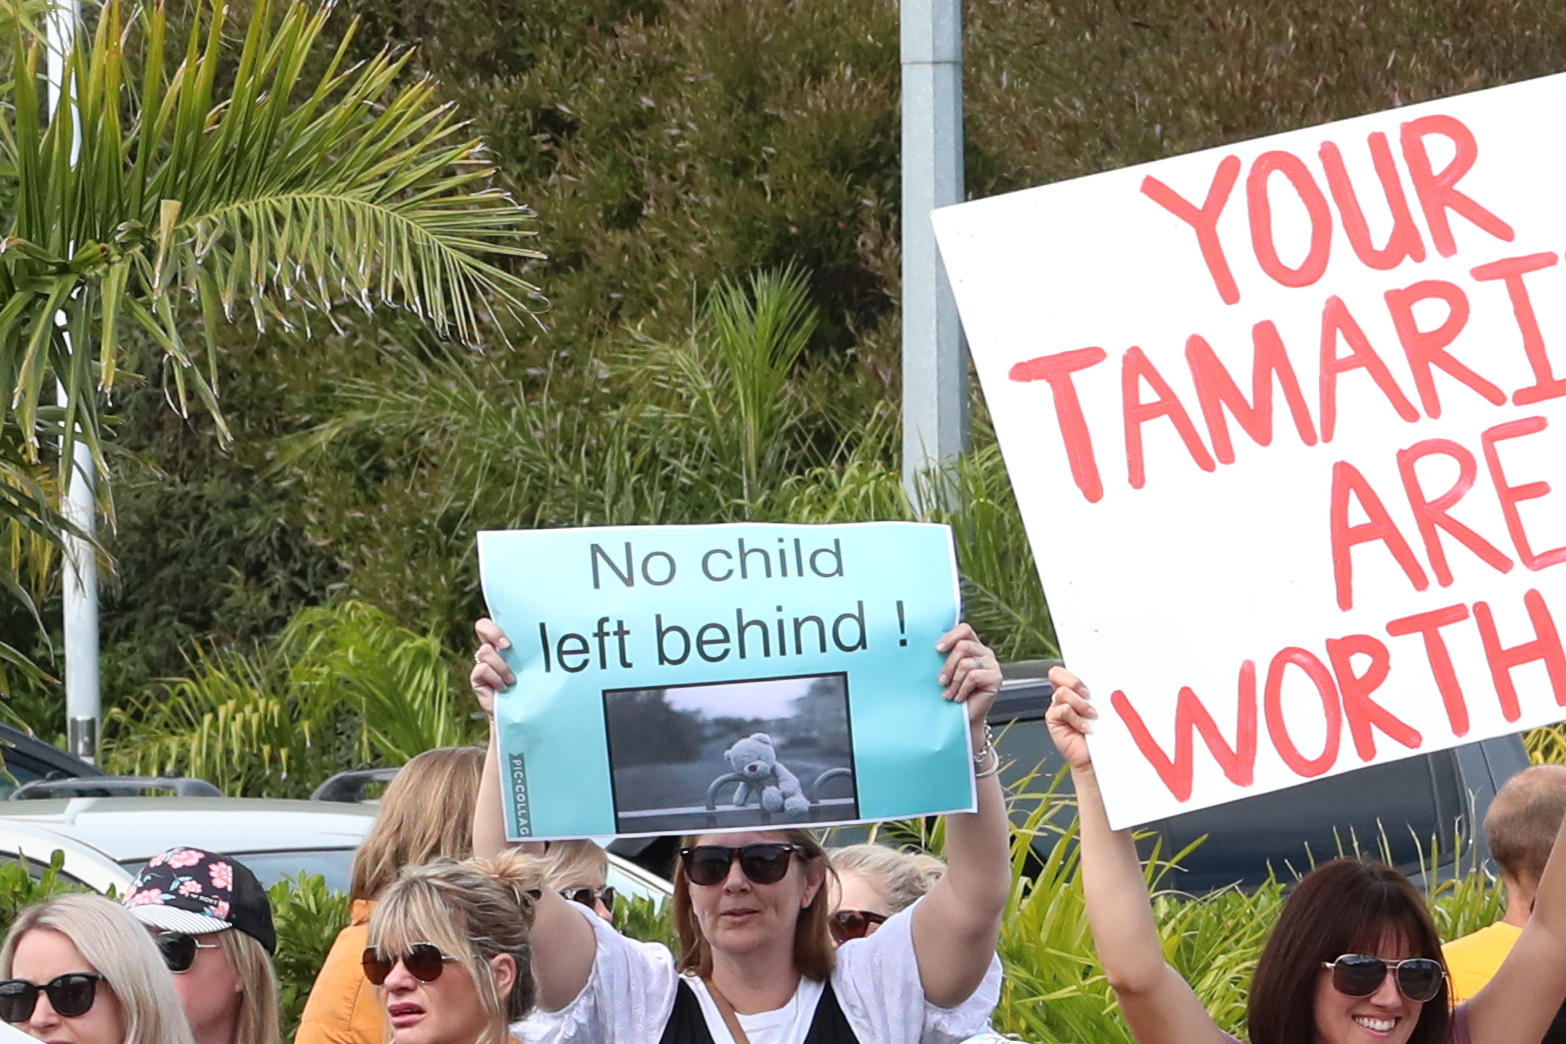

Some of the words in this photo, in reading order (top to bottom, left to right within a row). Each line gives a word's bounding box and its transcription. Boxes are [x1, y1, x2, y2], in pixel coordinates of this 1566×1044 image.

[1142, 115, 1514, 305] YOUR
[591, 540, 677, 589] No
[701, 536, 845, 582] child
[539, 616, 634, 673] left
[655, 600, 868, 667] behind
